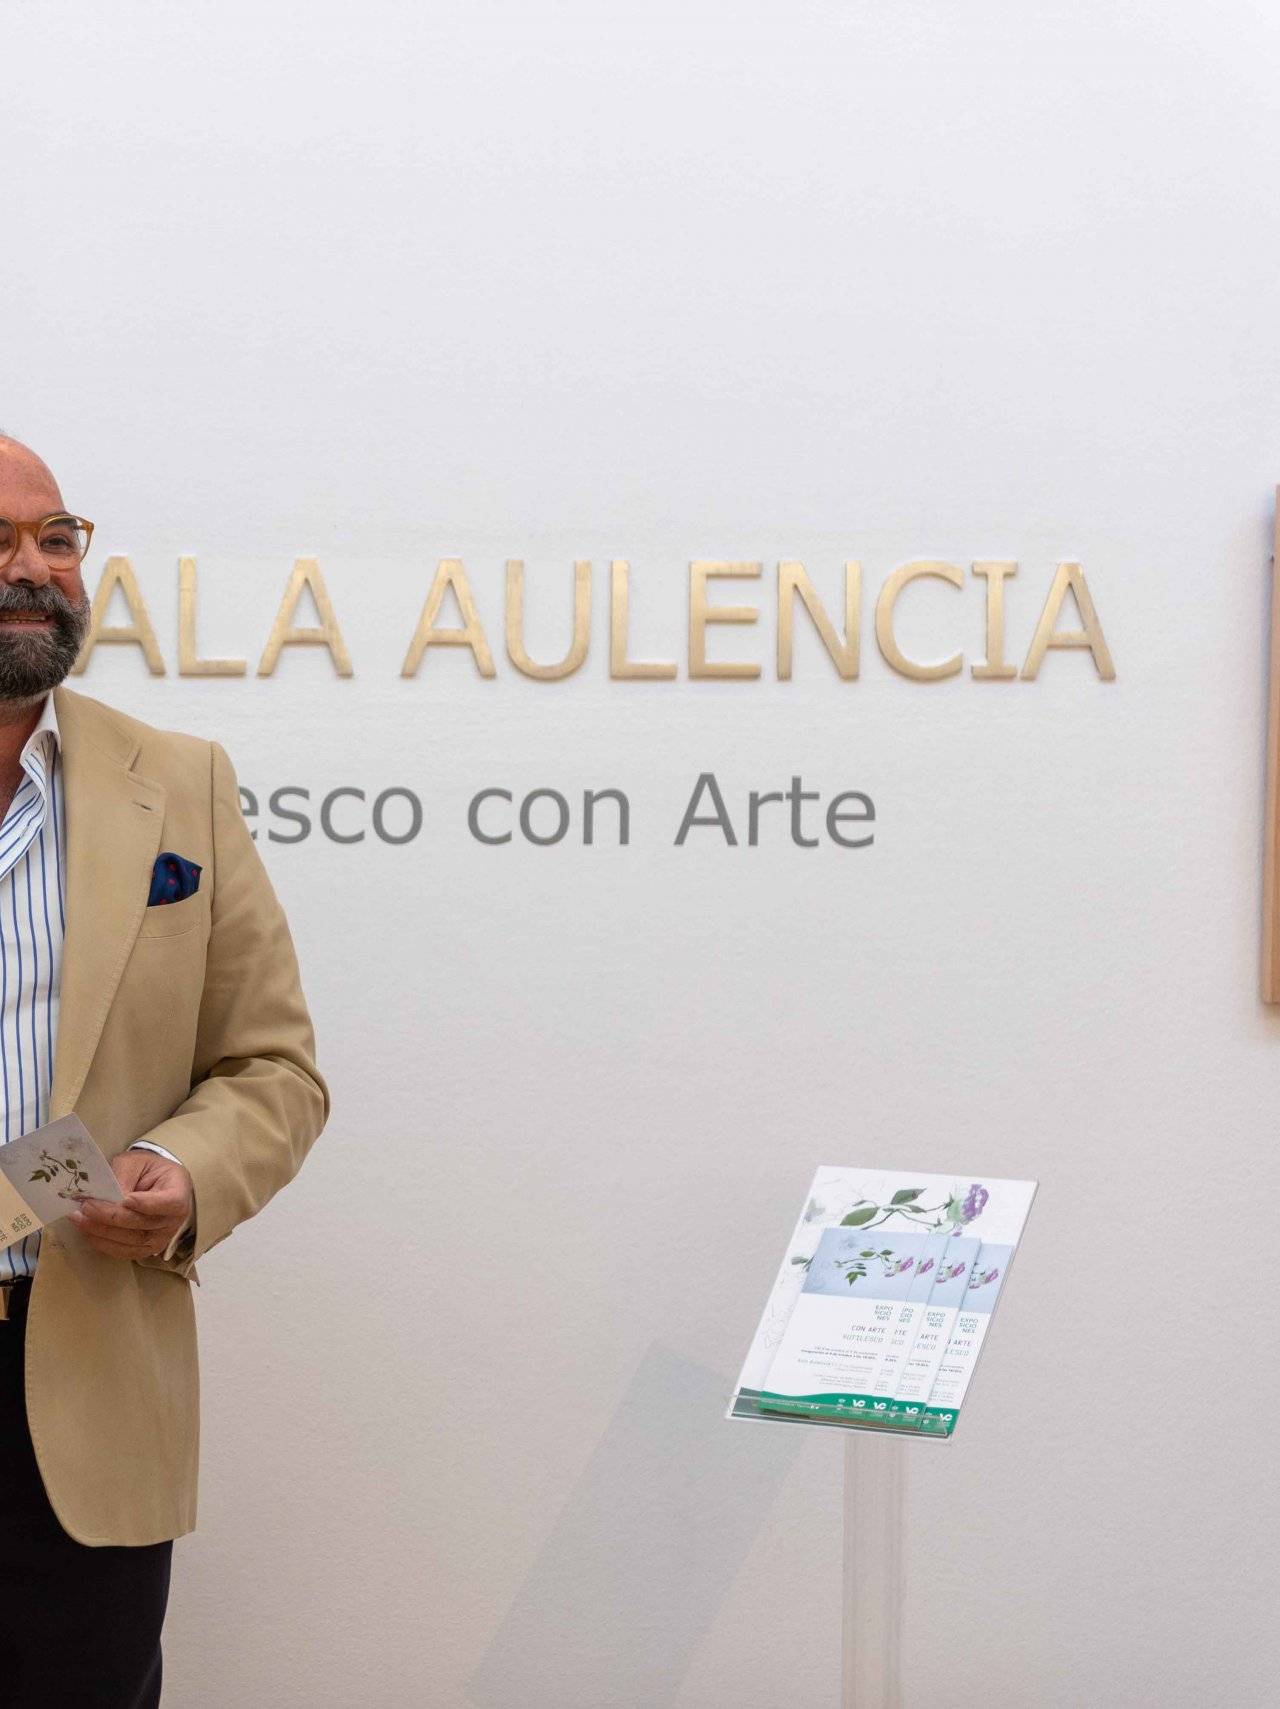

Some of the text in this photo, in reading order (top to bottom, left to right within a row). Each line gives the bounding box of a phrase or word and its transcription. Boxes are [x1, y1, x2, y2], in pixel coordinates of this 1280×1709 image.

[401, 557, 1116, 682] AULENCIA
[467, 786, 631, 847] con
[674, 772, 877, 848] Arte
[920, 1333, 939, 1341] ARTE
[953, 1339, 972, 1347] ARTE
